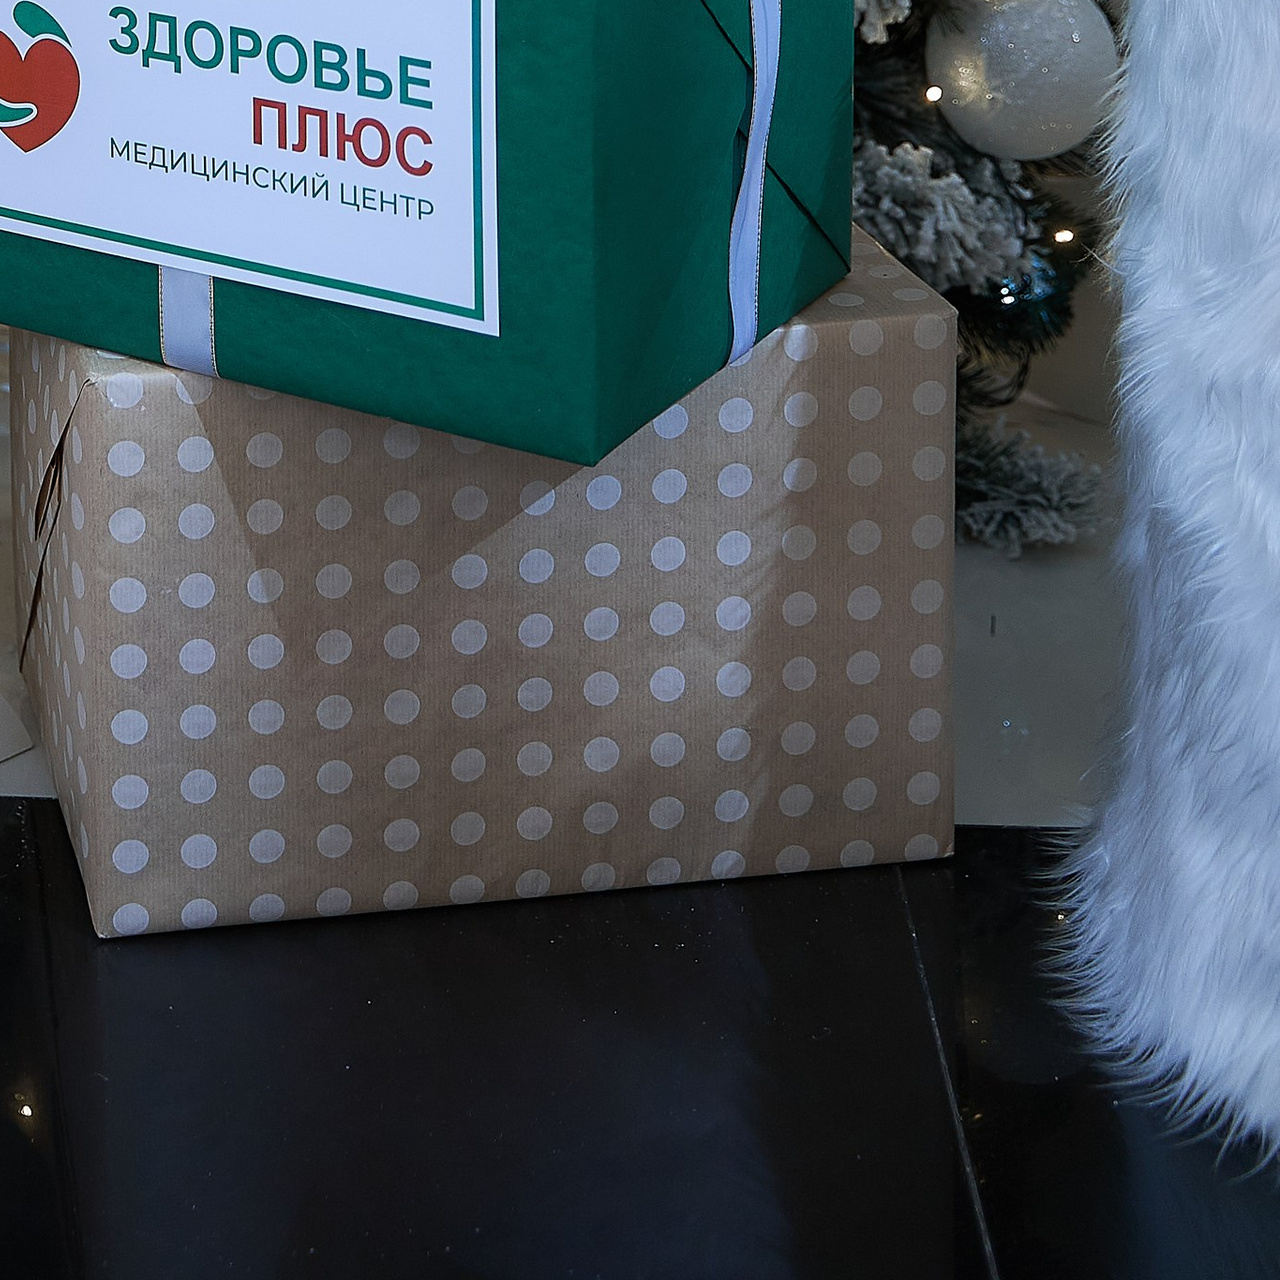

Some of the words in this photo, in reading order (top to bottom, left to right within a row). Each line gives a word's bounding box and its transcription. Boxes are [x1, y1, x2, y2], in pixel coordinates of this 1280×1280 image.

[108, 5, 433, 110] ЗДОРОВЬЕ
[109, 136, 330, 202] МЕДИЦИНСКИЙ
[339, 182, 435, 222] ЦЕНТР
[252, 96, 434, 177] ПЛЮС
